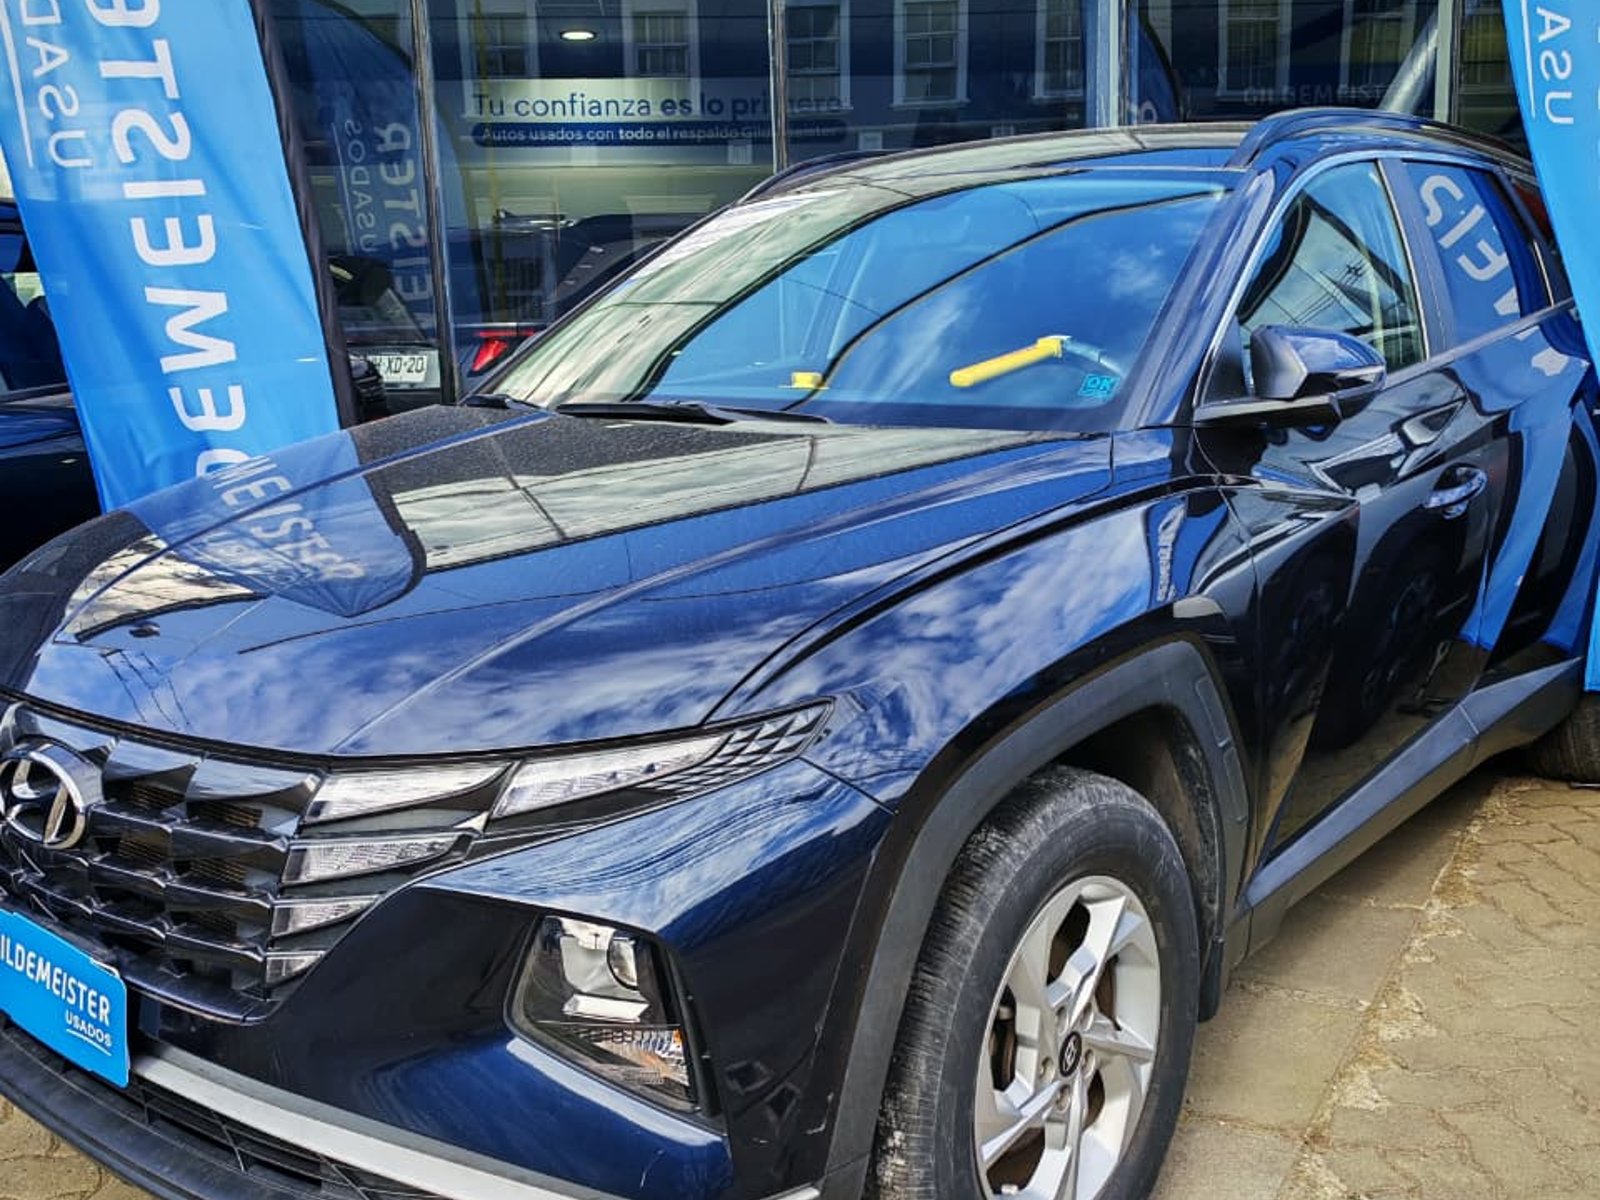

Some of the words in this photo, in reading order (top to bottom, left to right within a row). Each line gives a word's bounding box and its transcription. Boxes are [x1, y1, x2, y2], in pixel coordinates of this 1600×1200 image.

[473, 93, 504, 116] Tu
[514, 92, 651, 116] confianza
[660, 99, 692, 116] es
[701, 91, 724, 115] lo
[481, 128, 525, 140] Autos
[531, 127, 583, 141] usados
[586, 129, 614, 140] con
[618, 127, 654, 140] todo
[656, 126, 671, 139] el
[673, 126, 738, 142] respaldo
[0, 933, 110, 1025] ILDEMEISTER
[65, 1009, 112, 1047] USADOS
